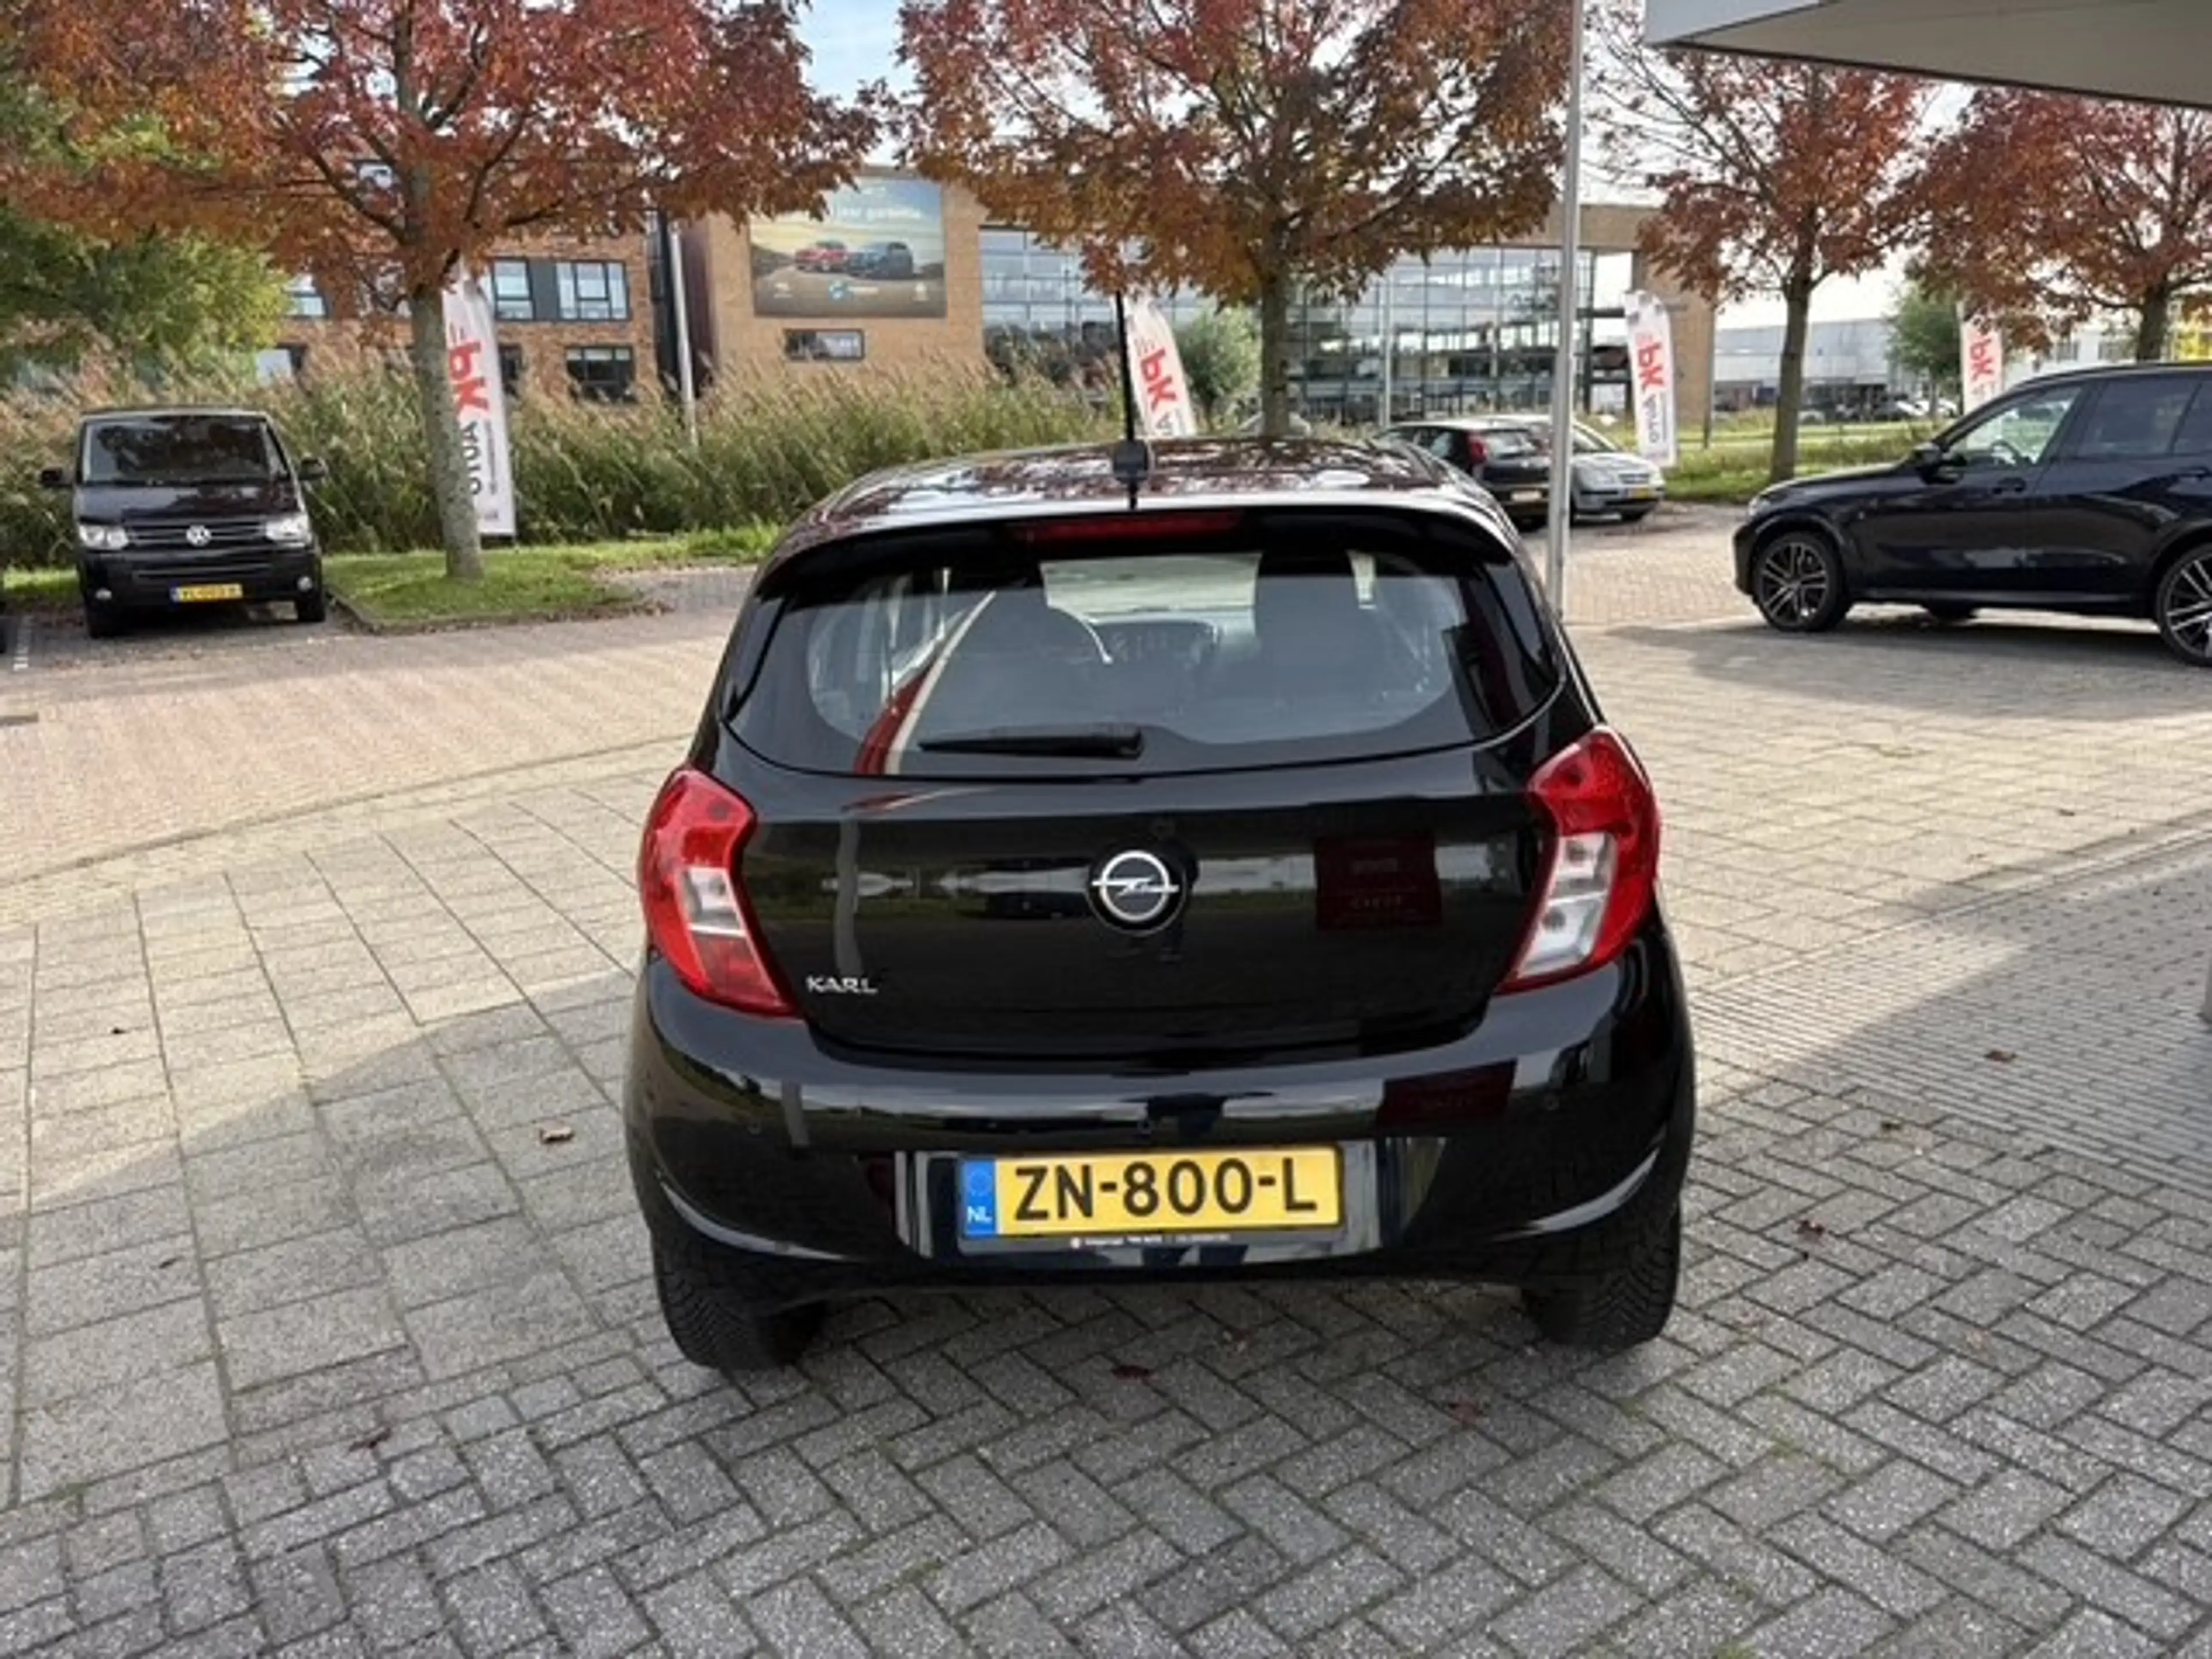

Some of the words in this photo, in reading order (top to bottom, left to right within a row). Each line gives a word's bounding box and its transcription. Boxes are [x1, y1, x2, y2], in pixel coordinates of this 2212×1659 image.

[806, 975, 878, 995] KARL
[1015, 1158, 1317, 1221] ZN-800-L
[967, 1206, 993, 1223] NL
